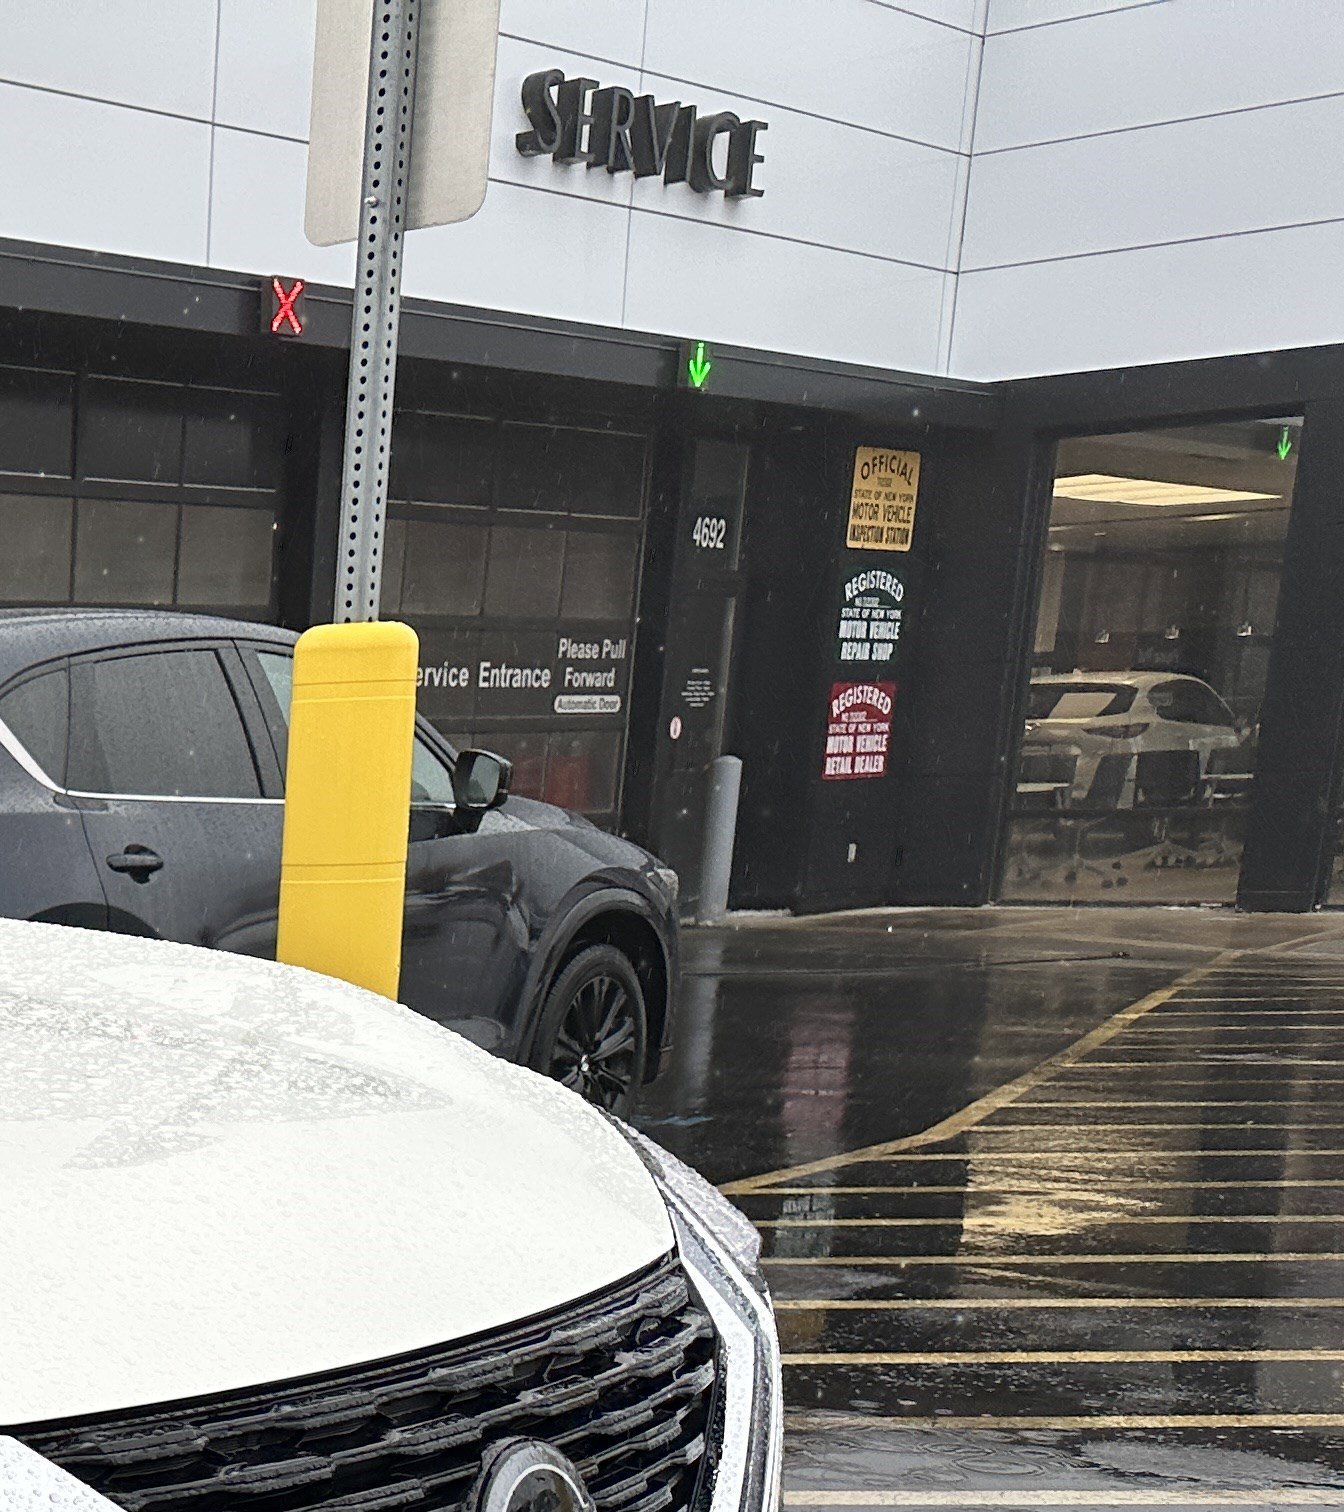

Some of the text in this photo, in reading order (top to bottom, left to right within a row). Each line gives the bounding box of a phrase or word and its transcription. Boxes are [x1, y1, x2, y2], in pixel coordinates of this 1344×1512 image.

[516, 69, 768, 199] SERVICE
[861, 454, 914, 486] OFFICIAL
[852, 501, 913, 523] MOTOR VEHICLE
[693, 517, 727, 548] 4692
[844, 570, 904, 602] REGISTERED
[838, 620, 901, 640] MOTOR VEHICLE
[558, 638, 626, 659] Please Pull
[840, 641, 894, 661] REPAIR SHOP
[416, 661, 551, 688] ervice Entrance
[564, 667, 616, 688] Forward
[831, 685, 892, 717] REGISTERED
